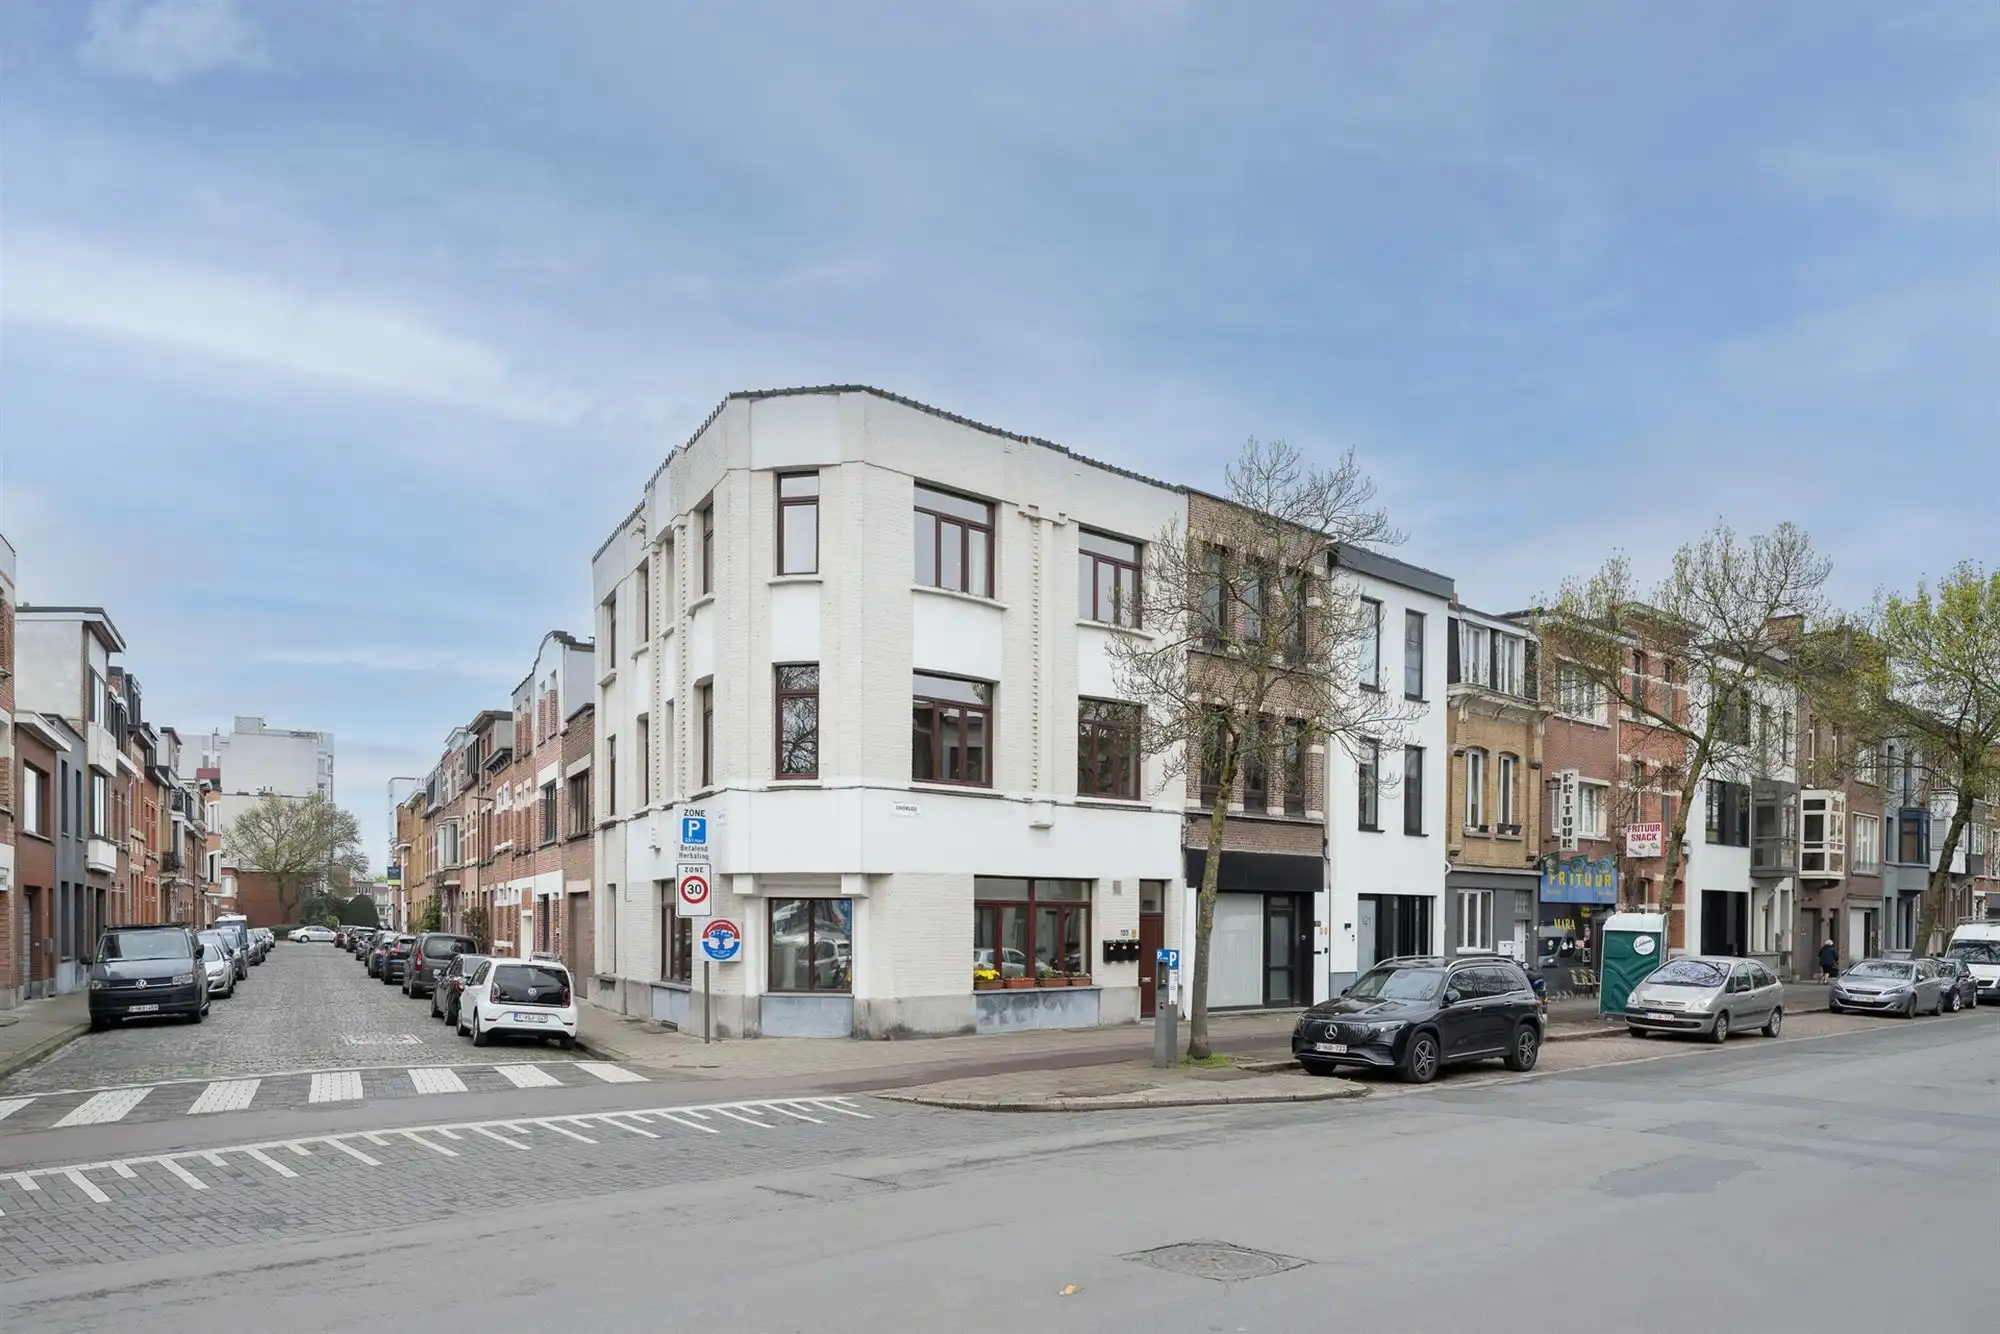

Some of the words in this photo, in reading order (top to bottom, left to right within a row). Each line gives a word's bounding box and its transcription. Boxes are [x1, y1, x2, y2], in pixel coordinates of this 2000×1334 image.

[684, 809, 706, 817] ZONE
[1562, 772, 1574, 848] FRITUUR
[688, 819, 701, 838] P
[1627, 823, 1661, 833] FRITUUR
[1631, 833, 1657, 841] SNACK
[687, 884, 702, 895] 30
[1553, 917, 1576, 931] MARA
[1169, 951, 1177, 967] P
